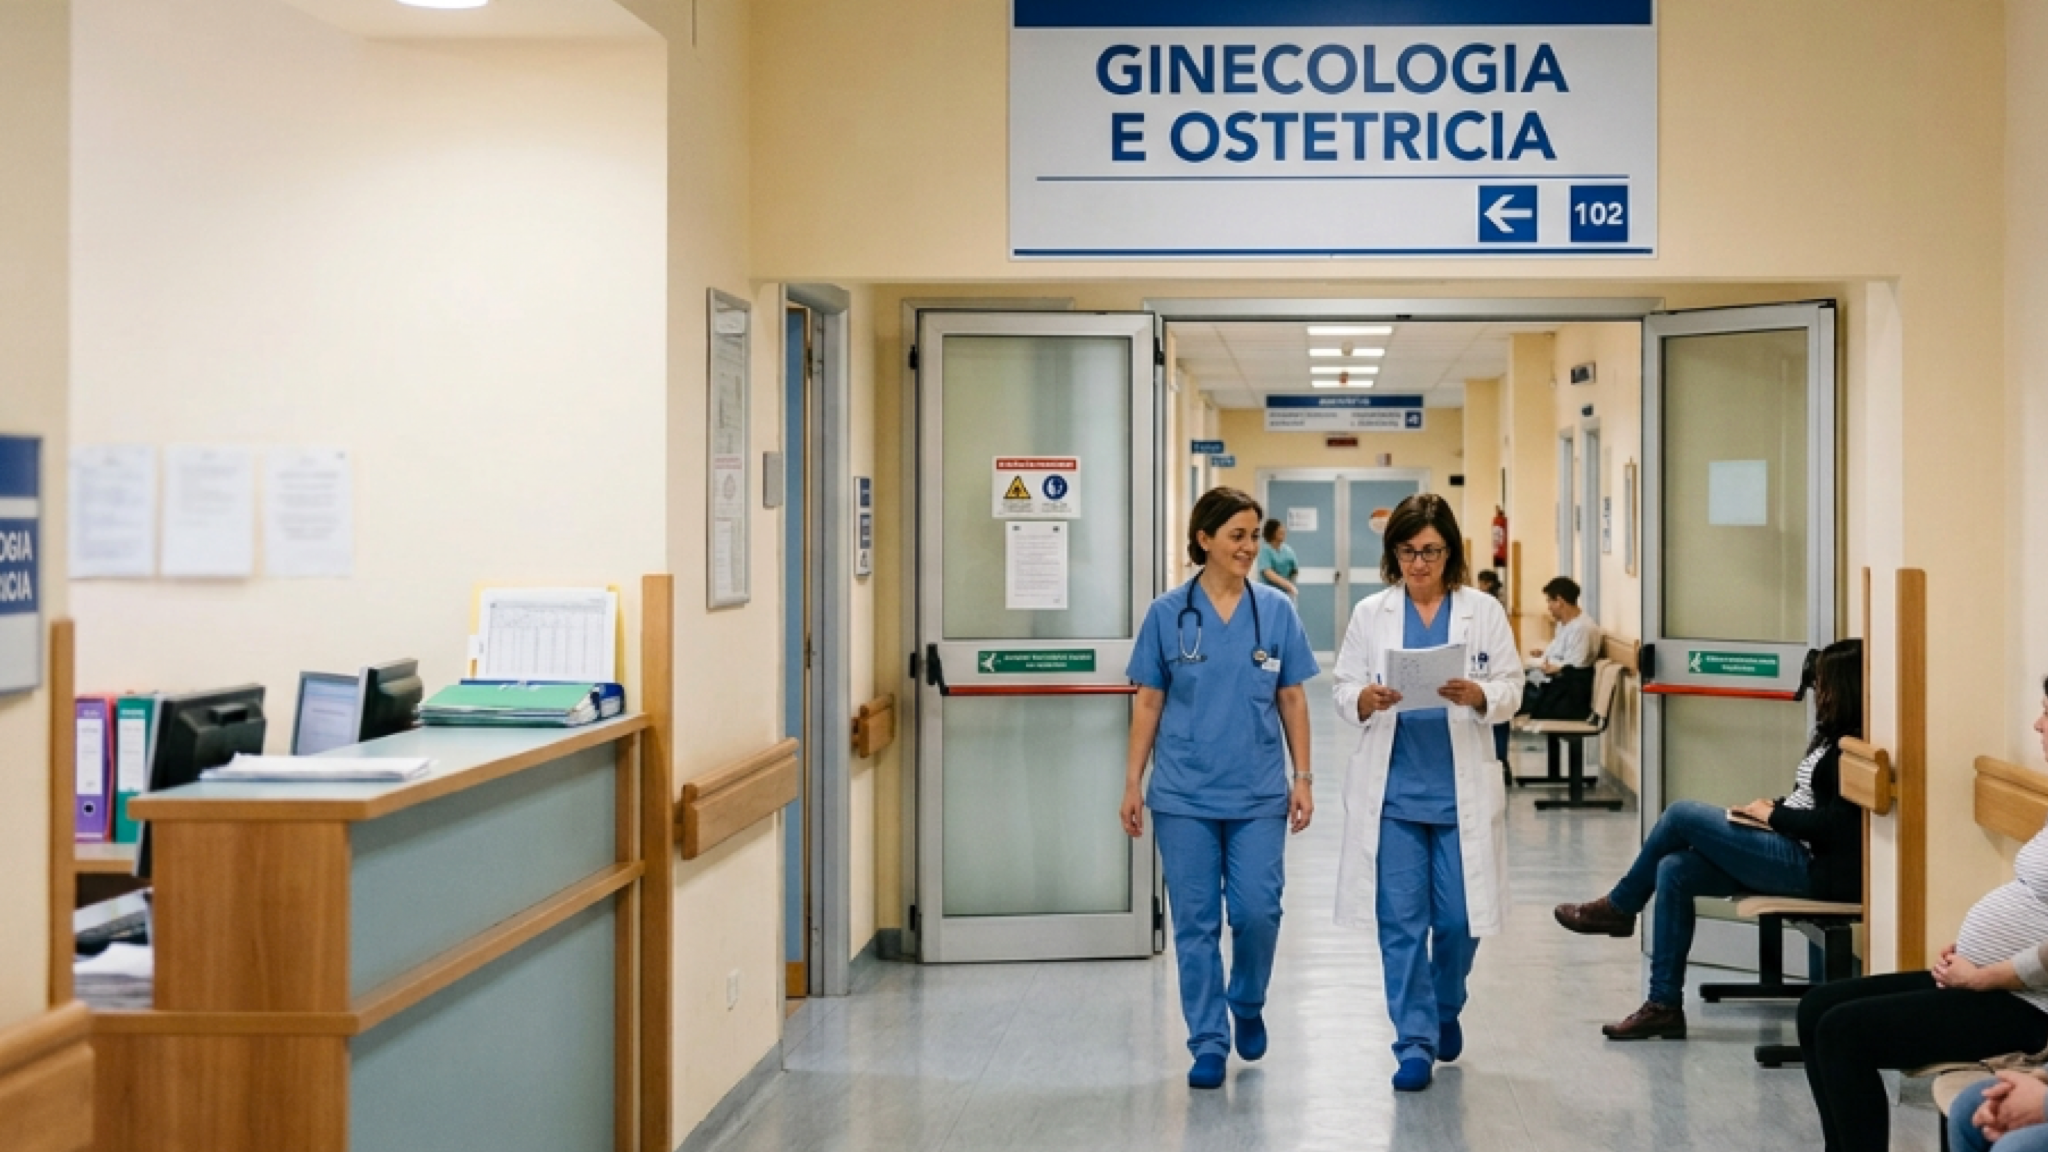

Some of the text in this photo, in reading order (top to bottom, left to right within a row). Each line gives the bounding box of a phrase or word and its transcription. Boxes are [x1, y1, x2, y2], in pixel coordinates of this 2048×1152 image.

[1096, 43, 1570, 95] GINECOLOGIA
[1111, 110, 1557, 163] E OSTETRICIA
[1575, 203, 1623, 225] 102
